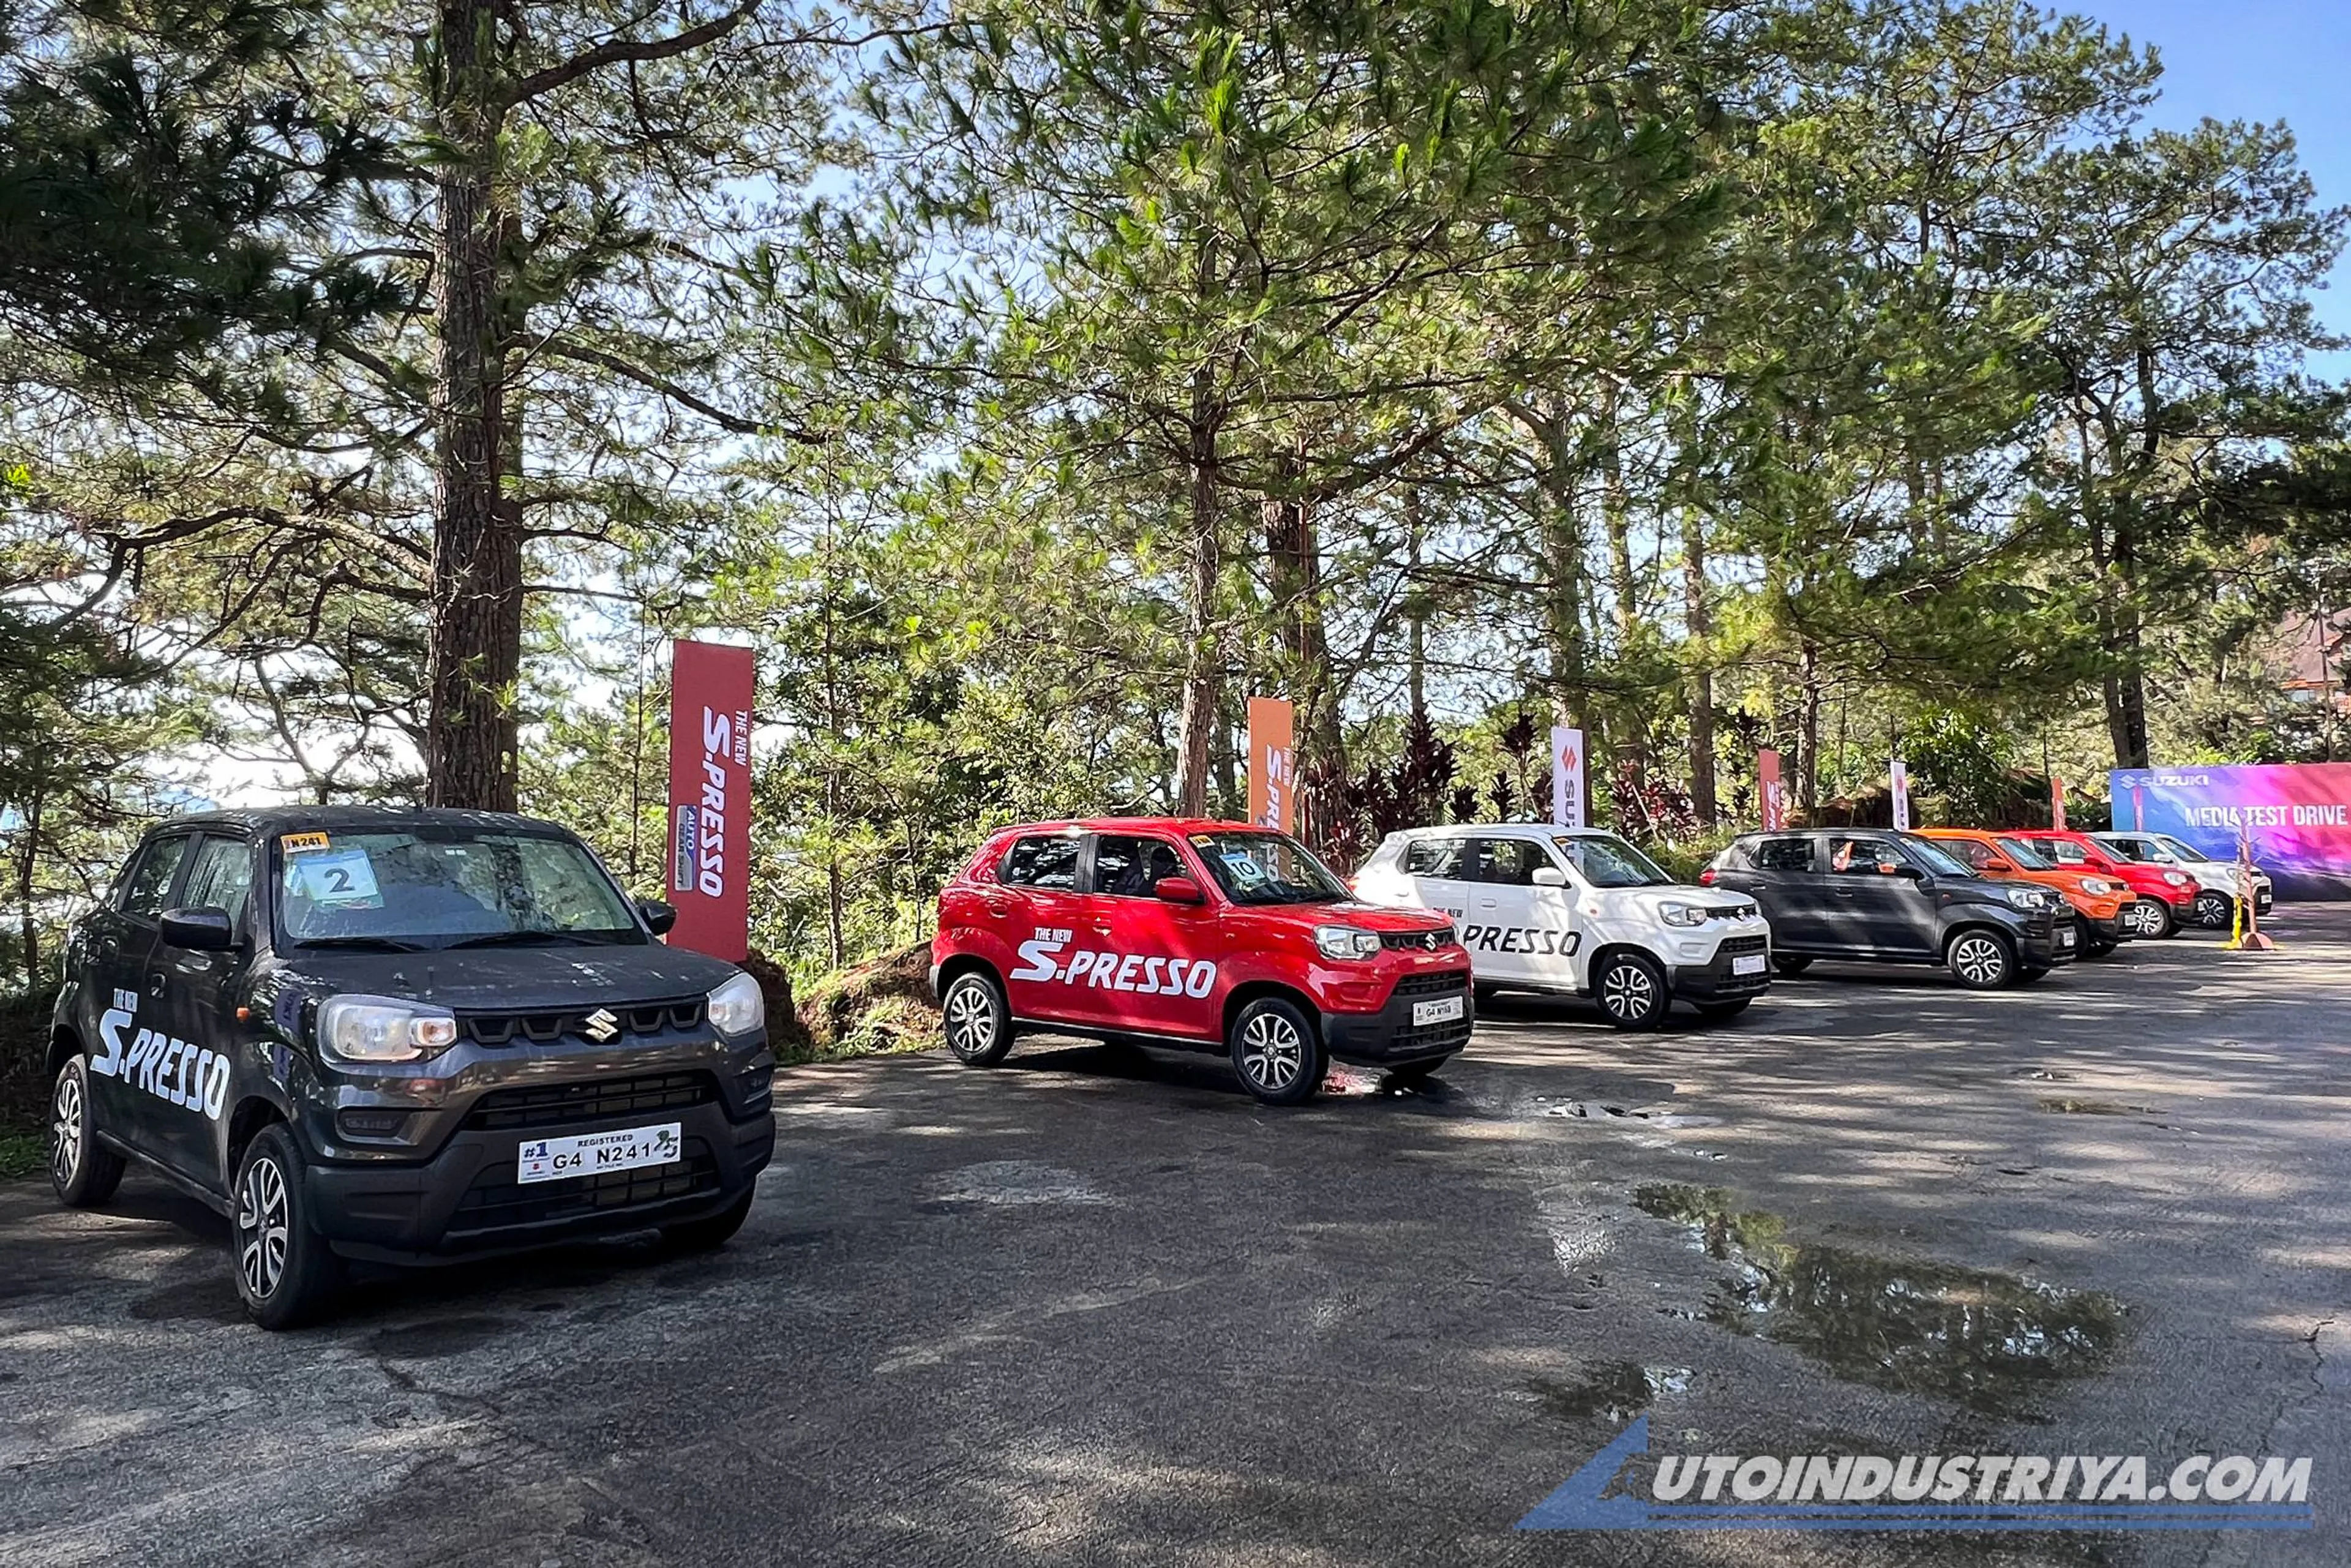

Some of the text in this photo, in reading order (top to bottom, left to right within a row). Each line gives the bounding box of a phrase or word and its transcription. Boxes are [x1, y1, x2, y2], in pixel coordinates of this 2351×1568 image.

[735, 710, 748, 766] THE NEW
[2139, 774, 2209, 787] SUZUKI
[2184, 805, 2349, 827] MEDIA TEST DRIVE
[686, 810, 696, 850] AUTO
[1231, 861, 1256, 877] 10
[324, 868, 356, 893] 2
[1035, 926, 1073, 943] THE NEW
[523, 1141, 548, 1158] #1
[577, 1134, 633, 1147] REGISTERED
[553, 1152, 582, 1169] G4
[596, 1142, 650, 1164] N241
